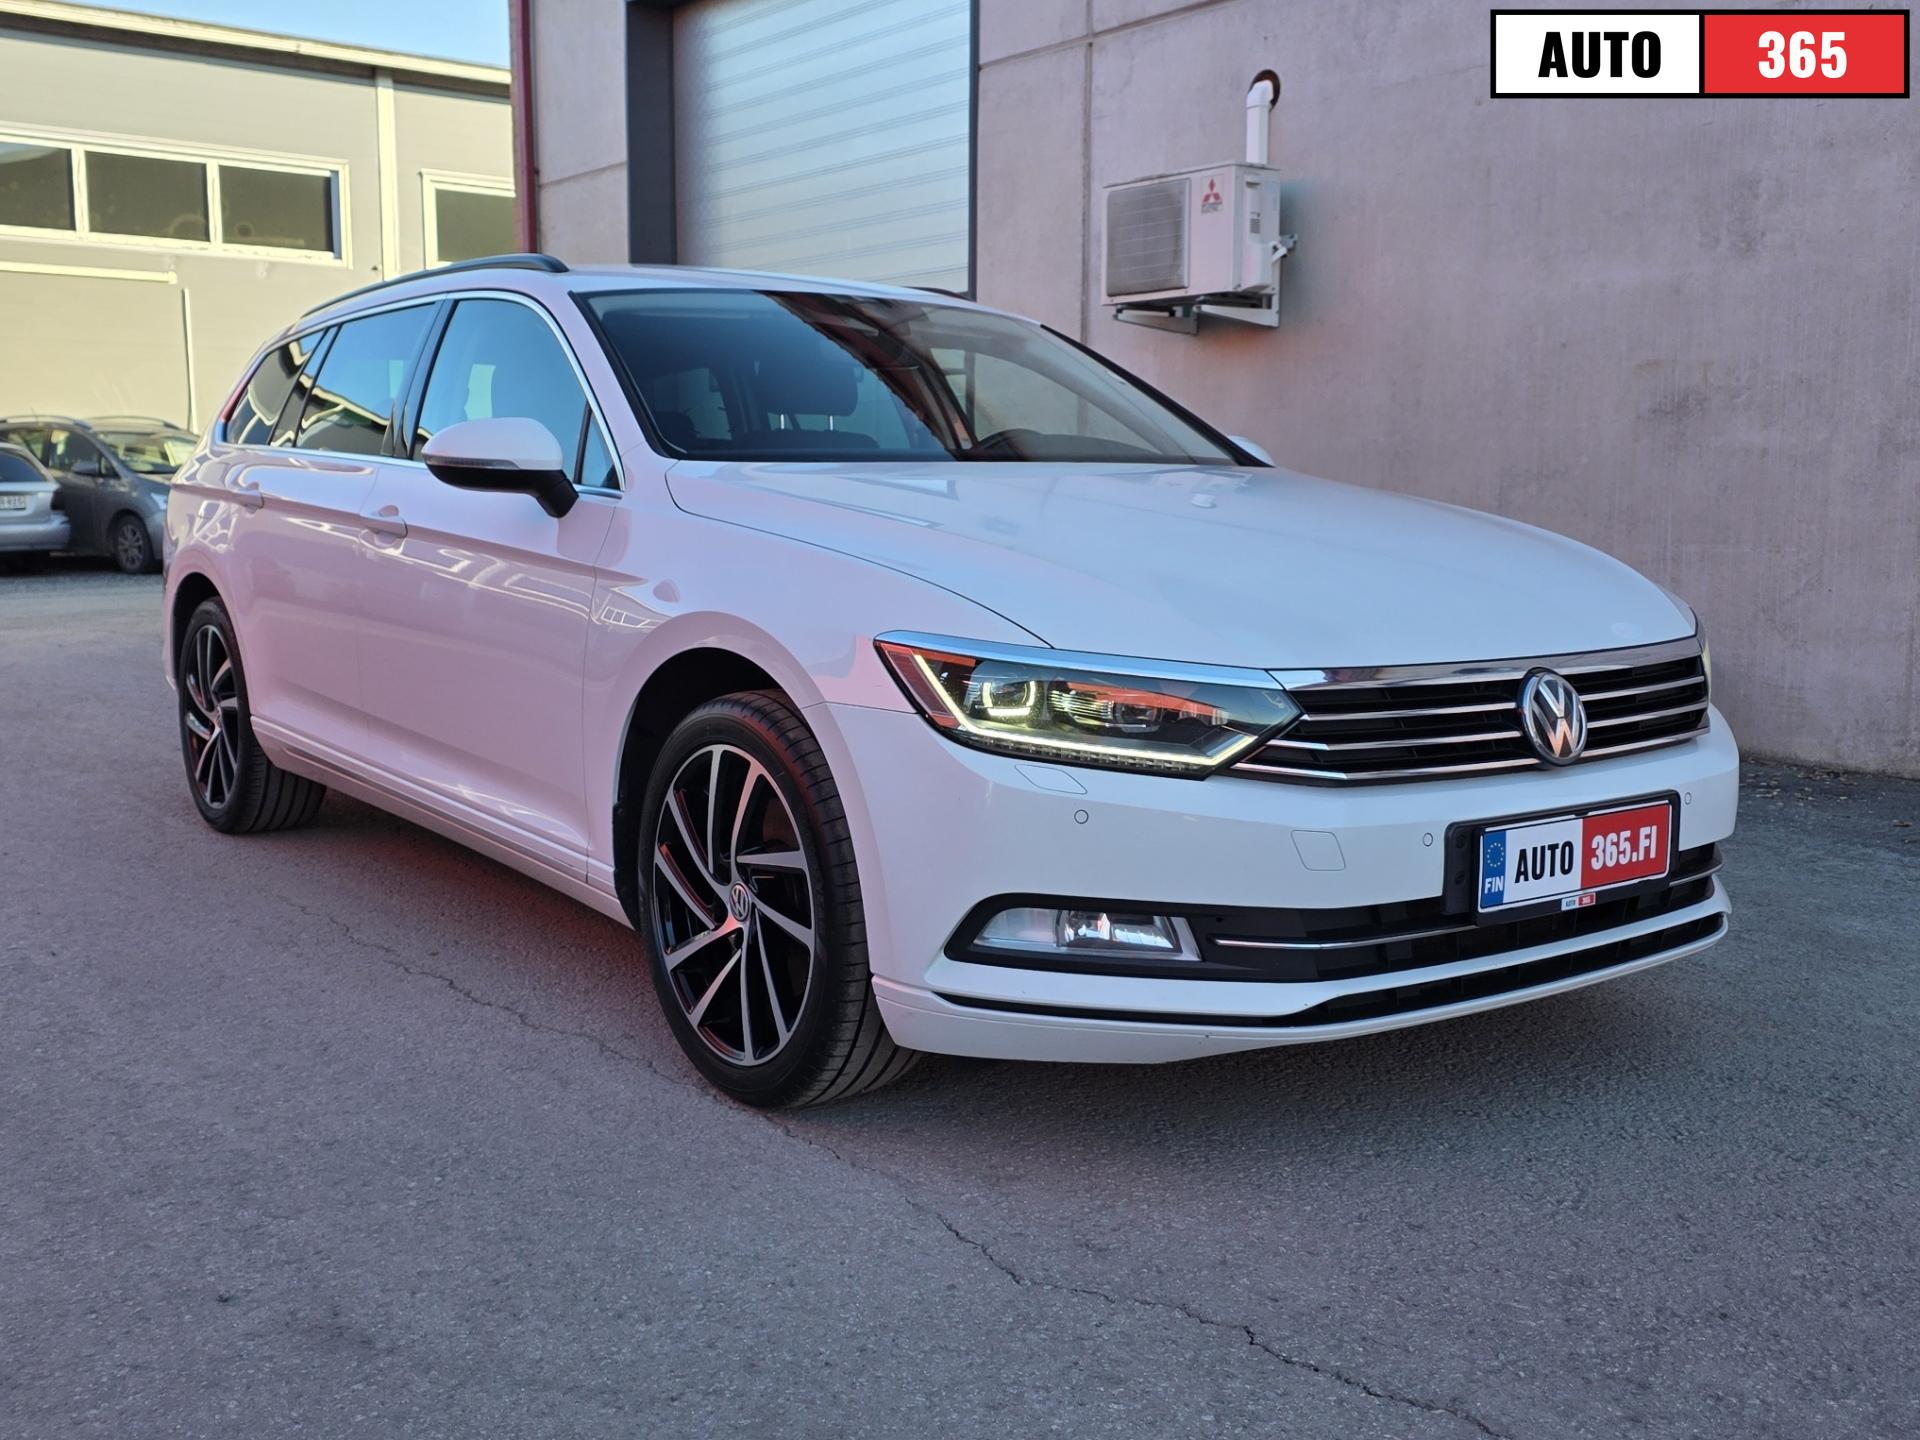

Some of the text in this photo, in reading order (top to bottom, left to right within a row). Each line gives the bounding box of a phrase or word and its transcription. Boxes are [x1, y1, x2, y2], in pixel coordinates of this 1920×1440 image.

[1515, 825, 1657, 884] AUTO 365.FI
[1484, 876, 1505, 894] FIN
